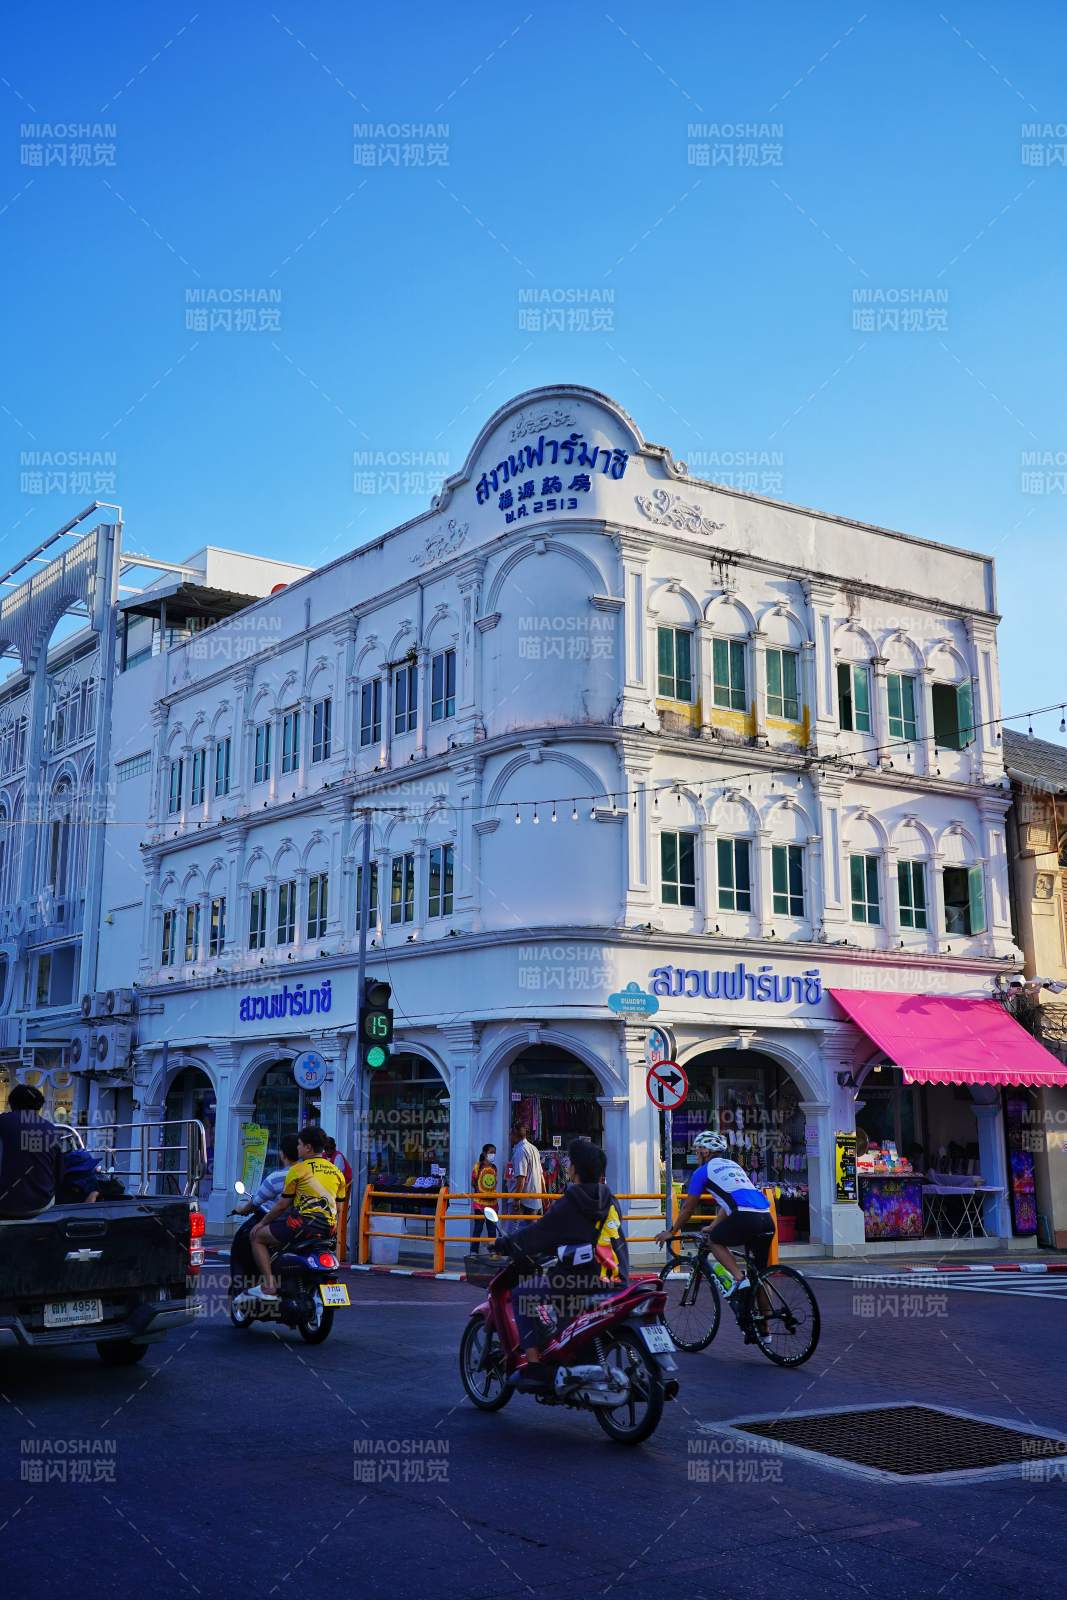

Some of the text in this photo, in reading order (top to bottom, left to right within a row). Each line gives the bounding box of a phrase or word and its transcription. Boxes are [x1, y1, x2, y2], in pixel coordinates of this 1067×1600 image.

[533, 497, 578, 514] 2513
[372, 1016, 387, 1036] 15
[72, 1299, 97, 1313] 4952
